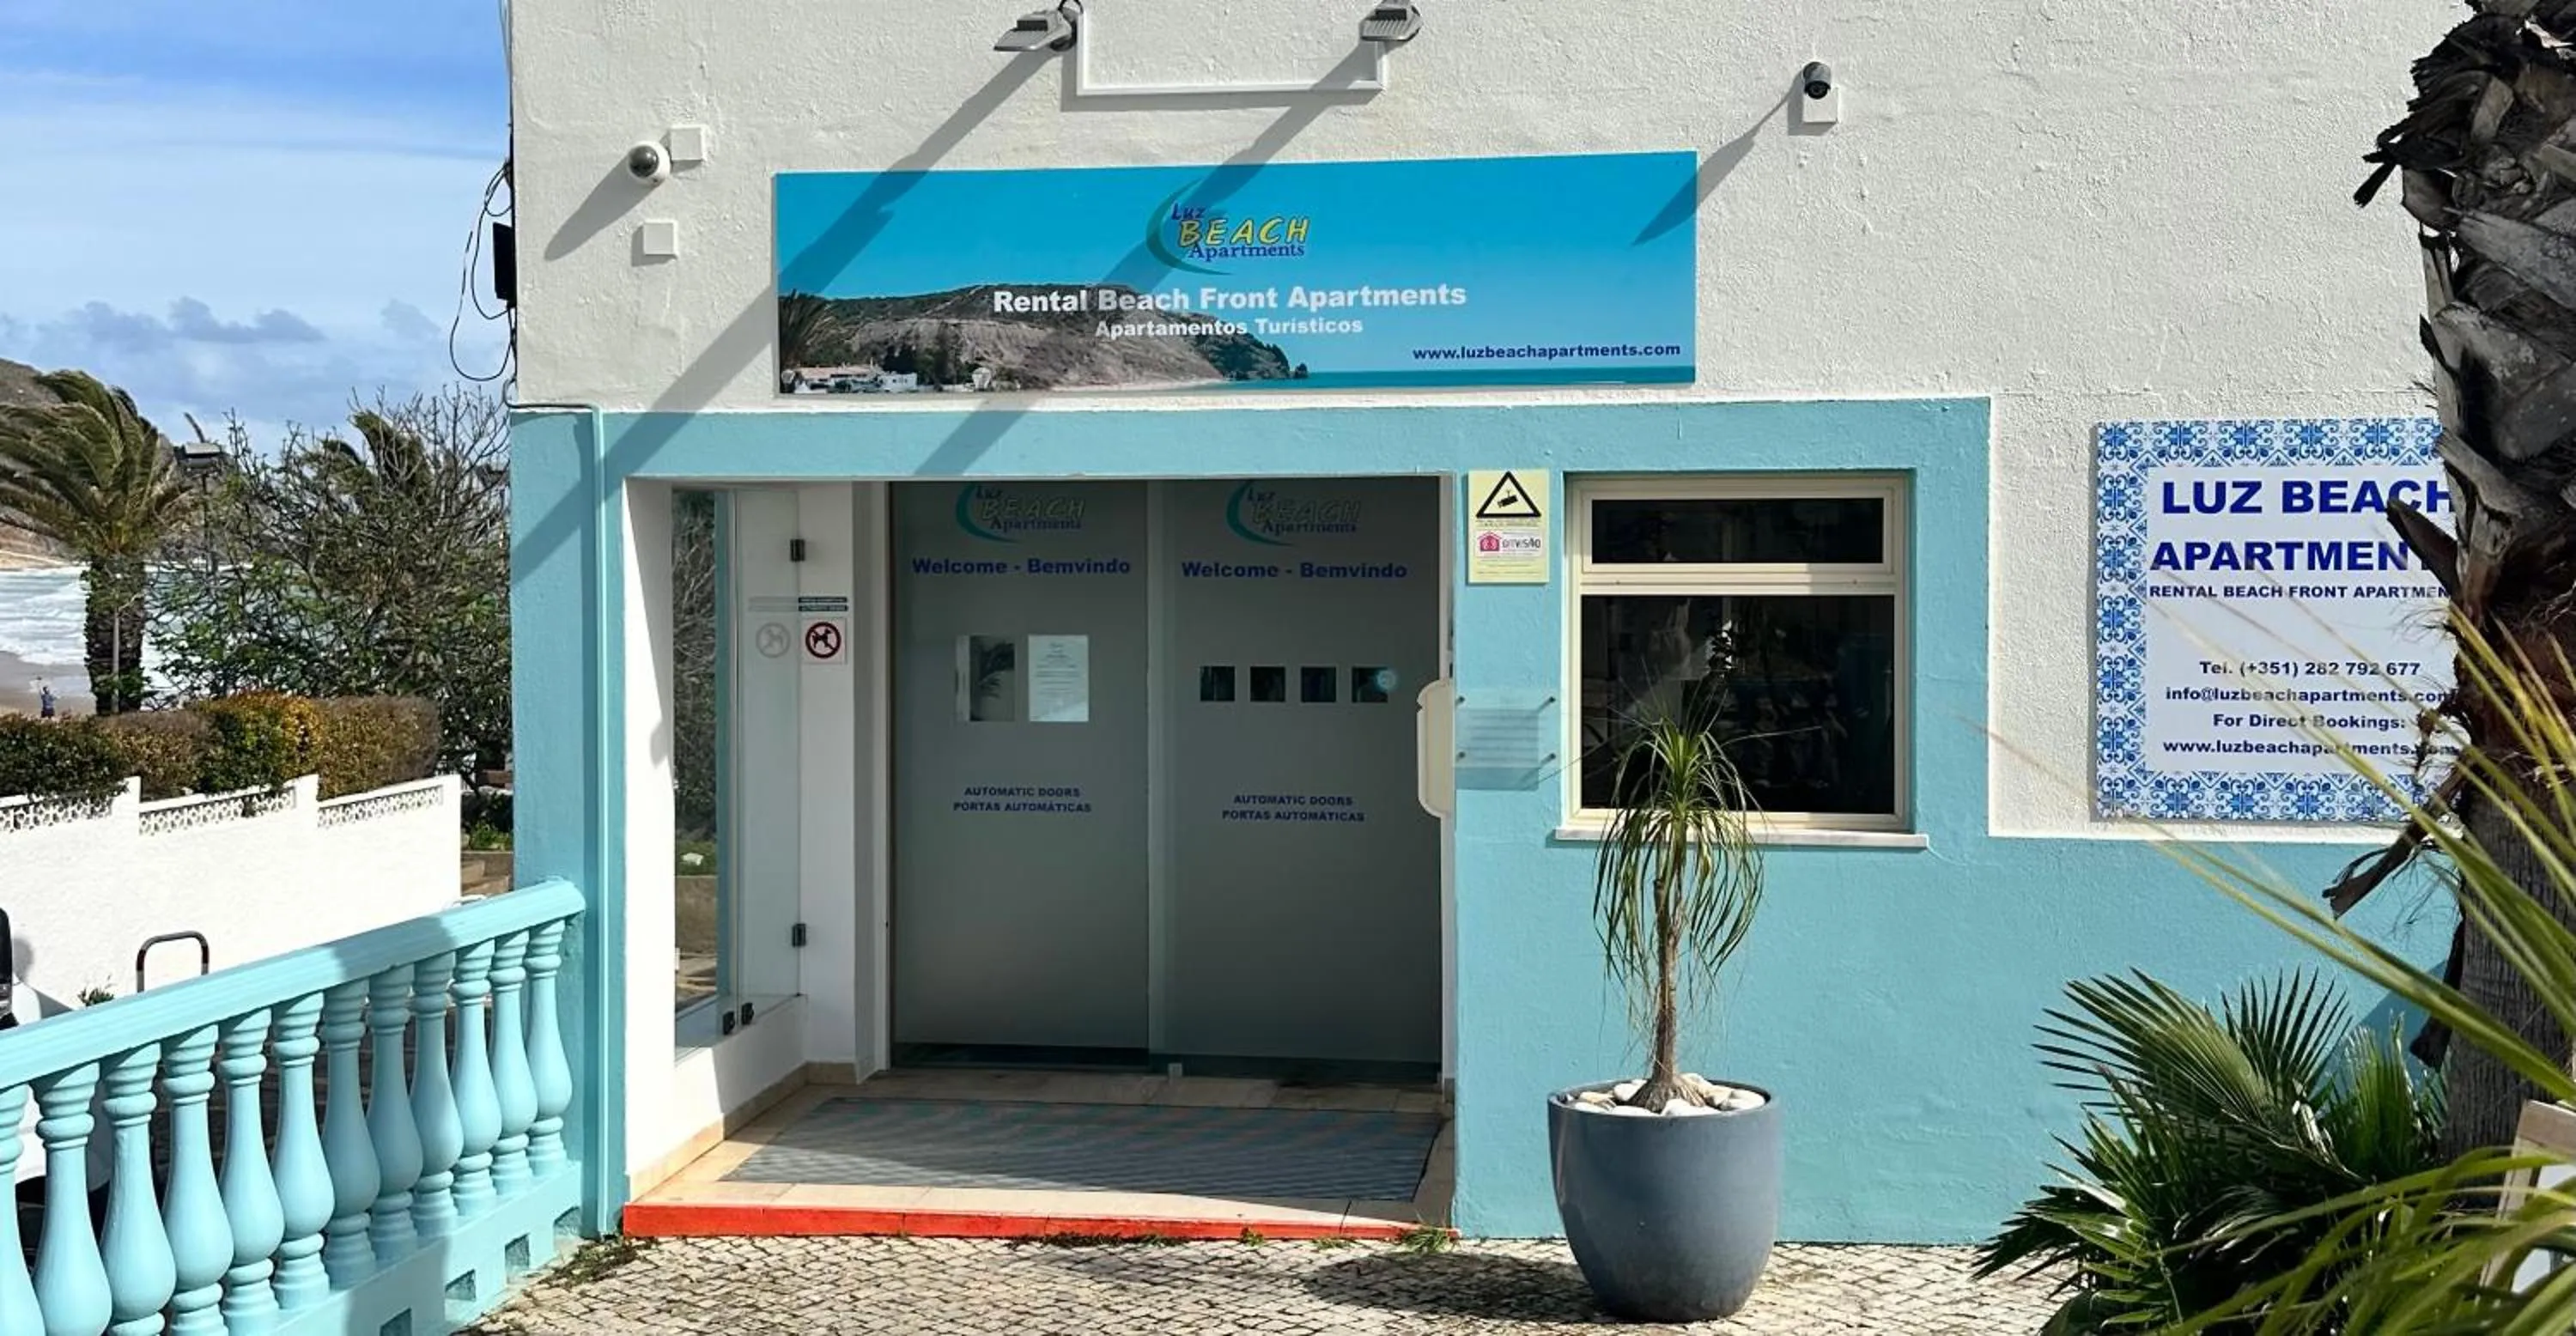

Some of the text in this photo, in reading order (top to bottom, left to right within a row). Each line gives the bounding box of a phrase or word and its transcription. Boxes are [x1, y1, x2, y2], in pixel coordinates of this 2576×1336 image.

[1171, 203, 1206, 221] Luz
[1177, 216, 1310, 247] BEACH
[1188, 243, 1305, 262] Apartments
[993, 283, 1467, 313] Rental Beach Front Apartments
[1095, 319, 1247, 340] Apartamentos
[1413, 343, 1680, 361] www.luzbeachapartments.com
[2162, 480, 2456, 514] LUZ BEACH
[982, 495, 1086, 521] BEACH
[1252, 497, 1363, 524] BEACH
[990, 519, 1082, 533] Apartments
[1261, 521, 1357, 536] Apartments
[2149, 541, 2432, 571] APARTMEN
[912, 558, 1007, 574] Welcome
[1028, 557, 1131, 574] Bemvindo
[1181, 562, 1279, 578] Welcome
[1300, 562, 1408, 578] Bemvindo
[2149, 586, 2450, 598] RENTAL BEACH FRONT APARTMEN
[2200, 660, 2233, 675] Tel.
[2239, 660, 2299, 677] (+351)
[2346, 661, 2380, 675] 792
[2386, 662, 2421, 675] 677
[2213, 714, 2405, 731] For Direct Bookings:
[2163, 741, 2460, 757] www.luzbeachapaments.om
[964, 786, 1081, 797] AUTOMATIC DOORS
[1233, 795, 1352, 805] AUTOMATIC DOORS
[953, 801, 1001, 811] PORTAS
[1222, 810, 1272, 821] PORTAS
